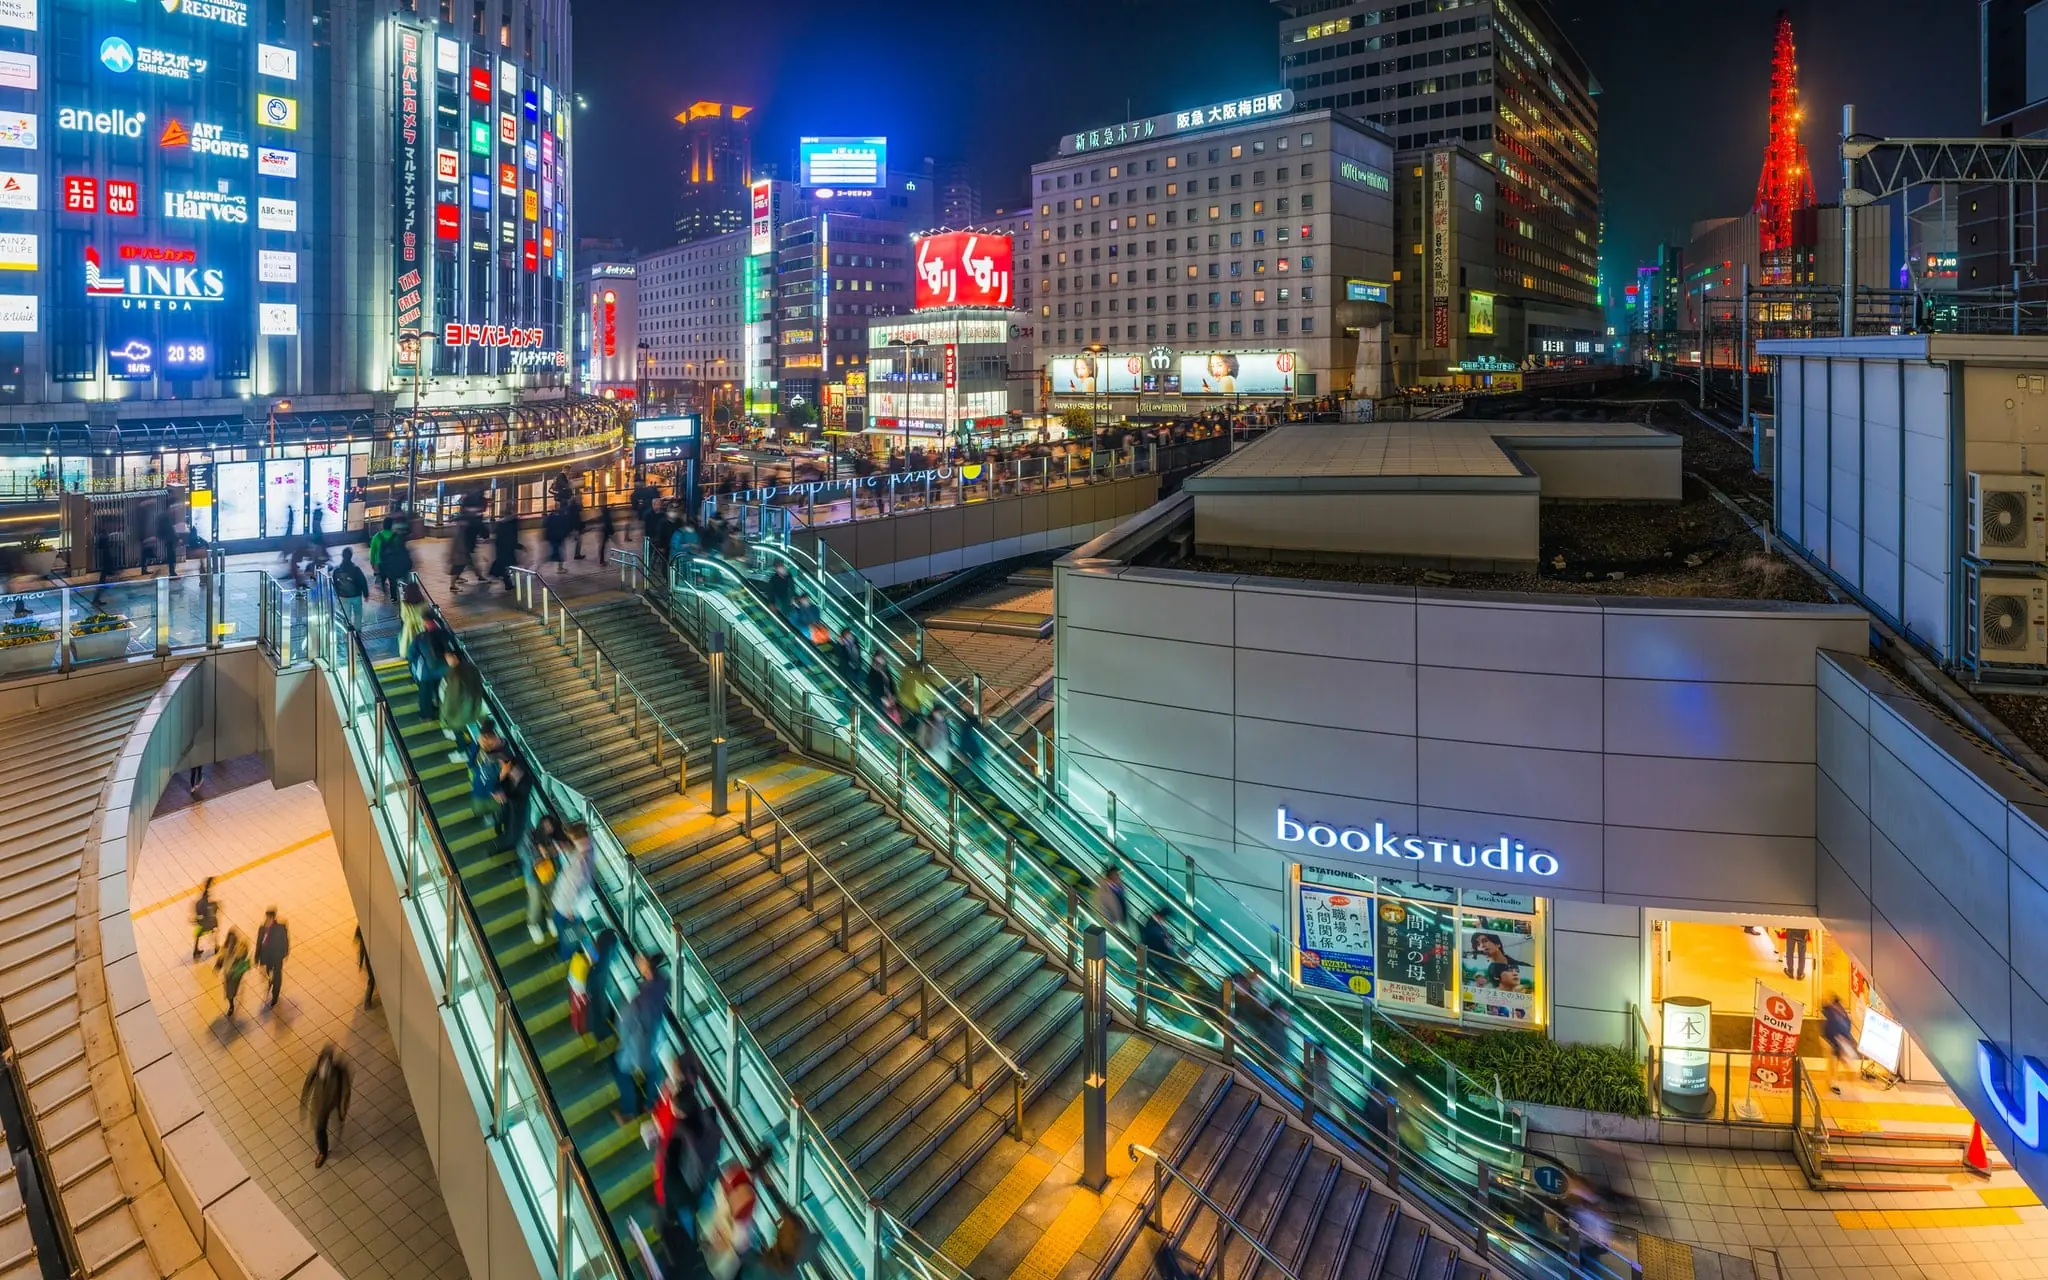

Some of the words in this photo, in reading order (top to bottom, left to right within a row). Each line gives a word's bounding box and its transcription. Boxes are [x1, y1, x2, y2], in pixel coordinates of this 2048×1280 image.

[182, 0, 247, 27] RESPIRE
[137, 47, 208, 73] 石井スポーツ
[137, 62, 157, 75] ISHII
[157, 66, 190, 79] SPORTS
[403, 34, 417, 144] ヨドバシカメラ
[1176, 111, 1205, 130] 阪急
[1208, 92, 1283, 122] 大阪梅田駅
[59, 107, 146, 138] anello
[192, 122, 223, 140] ART
[1075, 118, 1156, 151] 新阪急ホテル
[191, 138, 249, 159] SPORTS
[1341, 161, 1358, 182] HOTEL
[69, 180, 95, 194] ユニ
[109, 184, 132, 197] UNI
[69, 195, 95, 209] クロ
[109, 198, 135, 213] QLO
[164, 192, 249, 224] Harves
[261, 206, 294, 216] ABC-MART
[399, 269, 421, 291] TAX
[917, 240, 957, 303] くすり
[962, 236, 1008, 303] くすり
[122, 299, 192, 311] UMEDA
[398, 290, 421, 312] FREE
[445, 323, 544, 349] ヨドバシカメラ
[168, 345, 185, 361] 20
[188, 346, 206, 361] 38
[1148, 345, 1174, 355] HANKYU
[1276, 806, 1560, 877] bookstudio
[1316, 900, 1334, 949] 人間関係
[1331, 908, 1348, 944] 職場の
[1406, 914, 1426, 982] 間宵の母
[1774, 1000, 1787, 1017] R
[1678, 1016, 1702, 1039] 本
[1763, 1014, 1793, 1032] POINT
